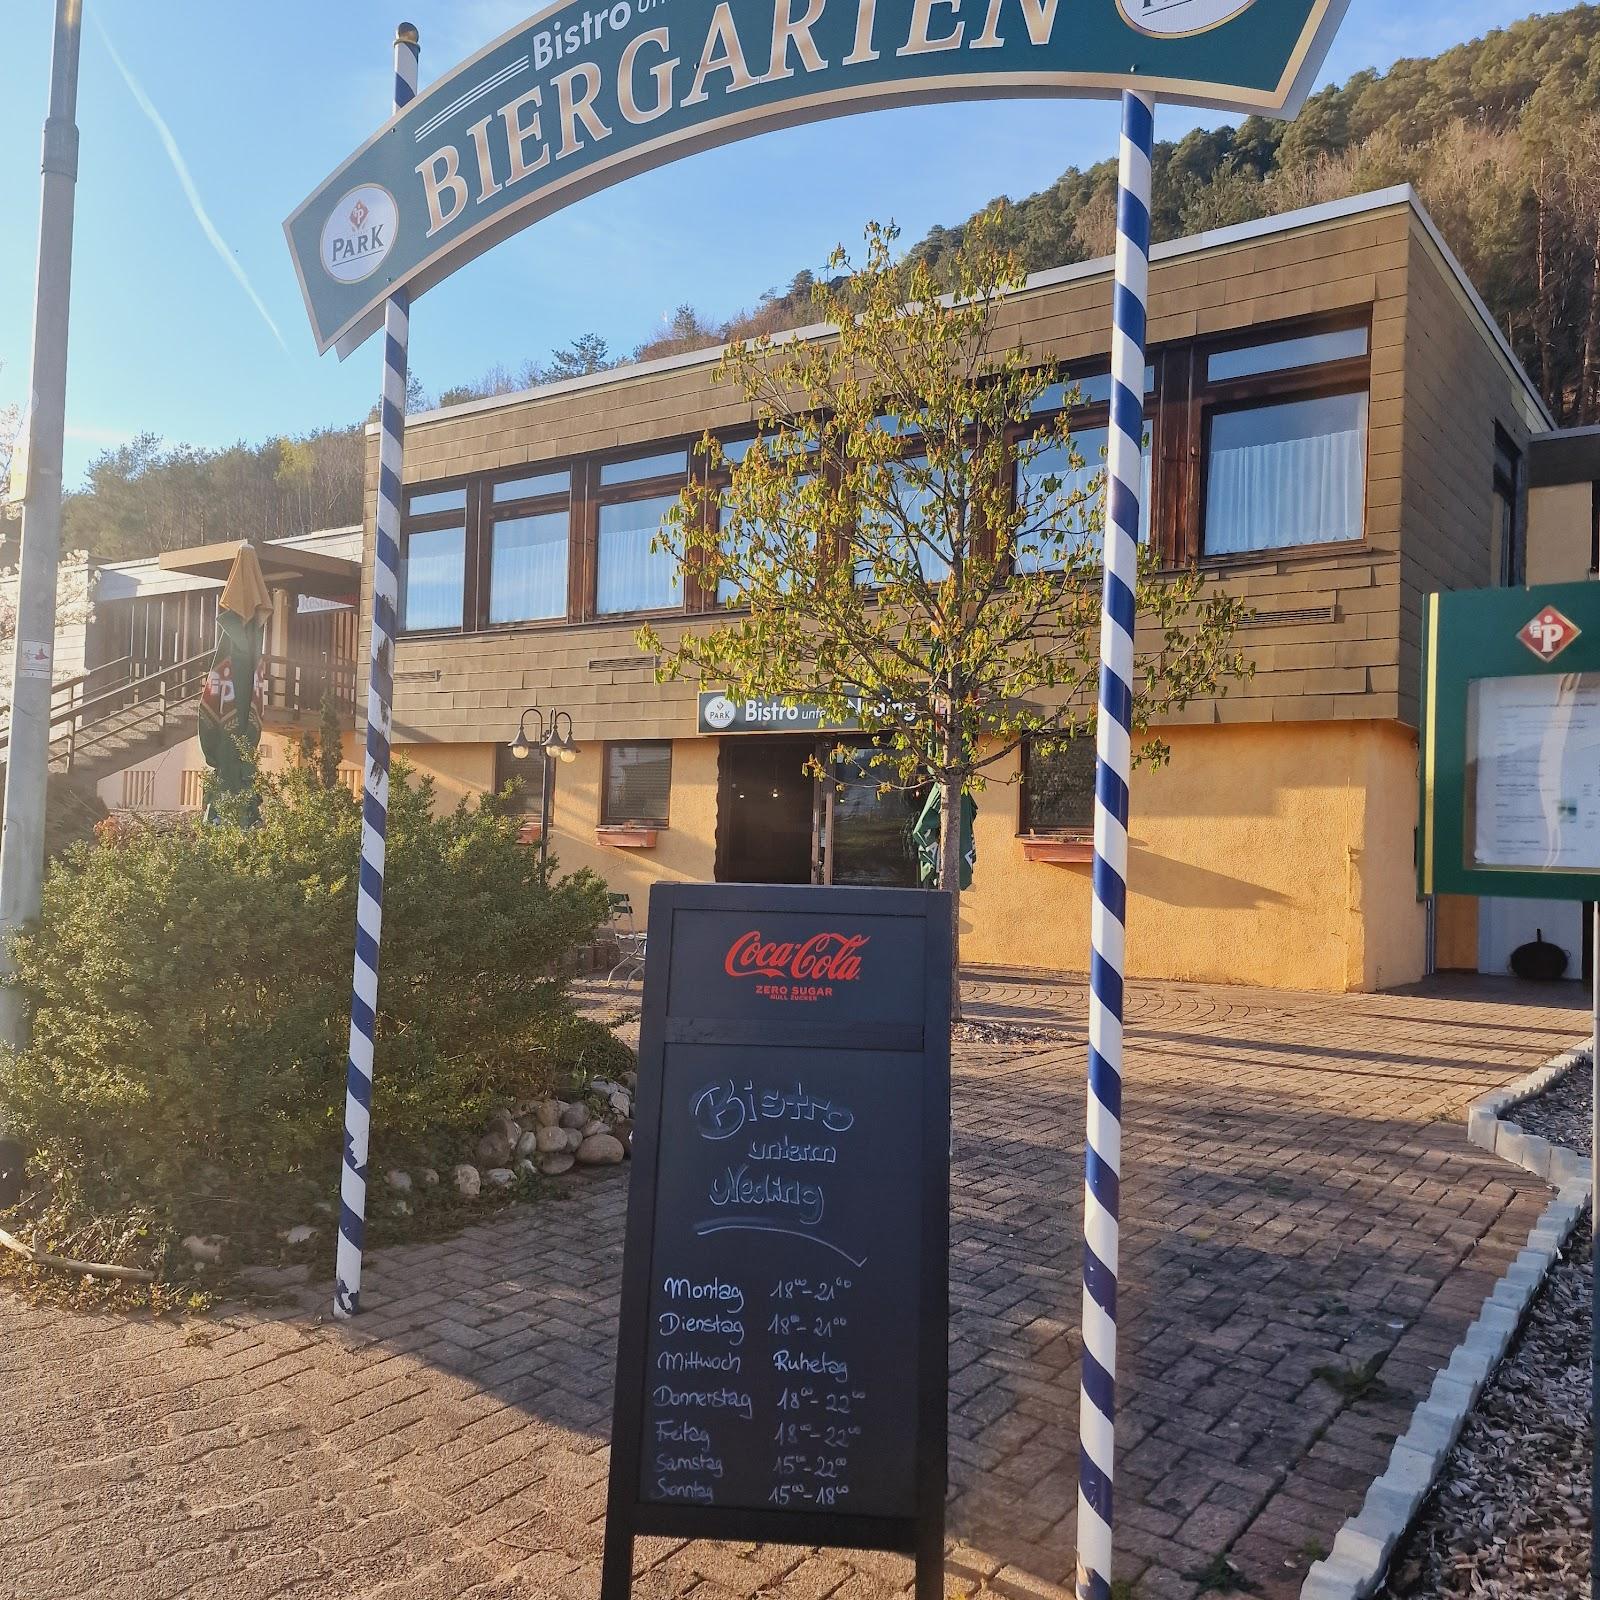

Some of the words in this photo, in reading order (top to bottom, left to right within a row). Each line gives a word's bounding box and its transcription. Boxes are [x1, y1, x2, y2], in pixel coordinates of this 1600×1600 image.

[533, 1, 631, 71] Bistro
[332, 224, 384, 262] PARK
[709, 711, 731, 720] PARK
[745, 699, 799, 721] Bistro
[725, 931, 871, 980] Coca-Cola
[755, 985, 788, 994] ZERO
[791, 986, 833, 996] SUGAR
[692, 1079, 854, 1140] Bistro
[664, 1277, 744, 1313] Montag
[659, 1313, 744, 1345] Dienstag
[657, 1351, 741, 1374] Mittwoch
[773, 1350, 848, 1383] Ruhetag
[653, 1385, 753, 1419] Donnerstag
[655, 1420, 710, 1451] Freitag
[656, 1454, 723, 1478] Samstag
[655, 1478, 714, 1505] Sonntag
